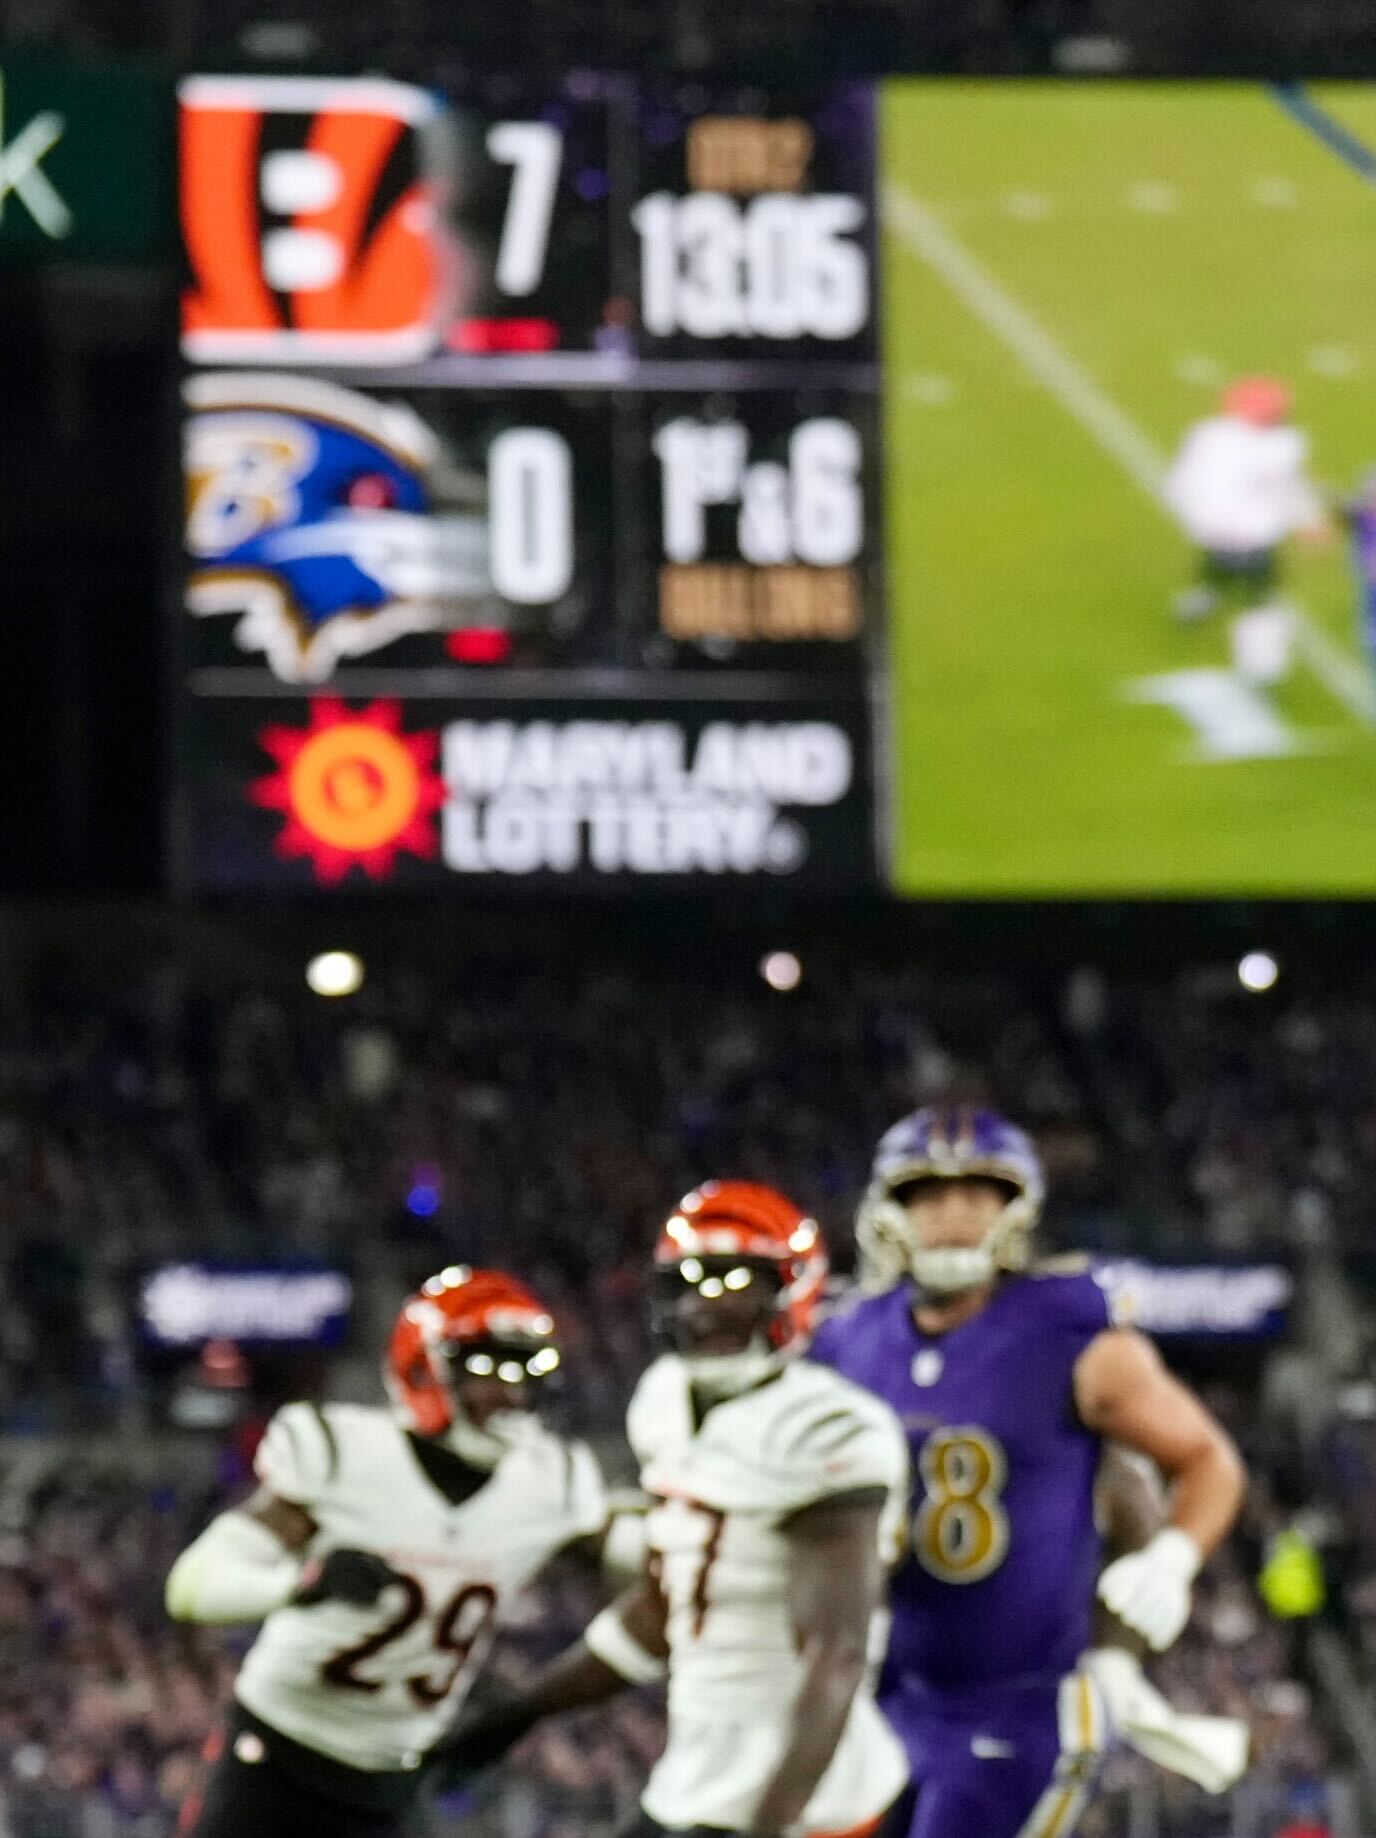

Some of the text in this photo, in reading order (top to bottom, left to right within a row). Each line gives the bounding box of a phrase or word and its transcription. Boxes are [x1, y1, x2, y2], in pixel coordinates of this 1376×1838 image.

[487, 121, 563, 298] 7
[634, 190, 868, 340] 13:05
[488, 427, 573, 603] 0
[788, 416, 864, 566] 6
[442, 719, 852, 806] MARYLAND
[323, 1571, 498, 1709] 29
